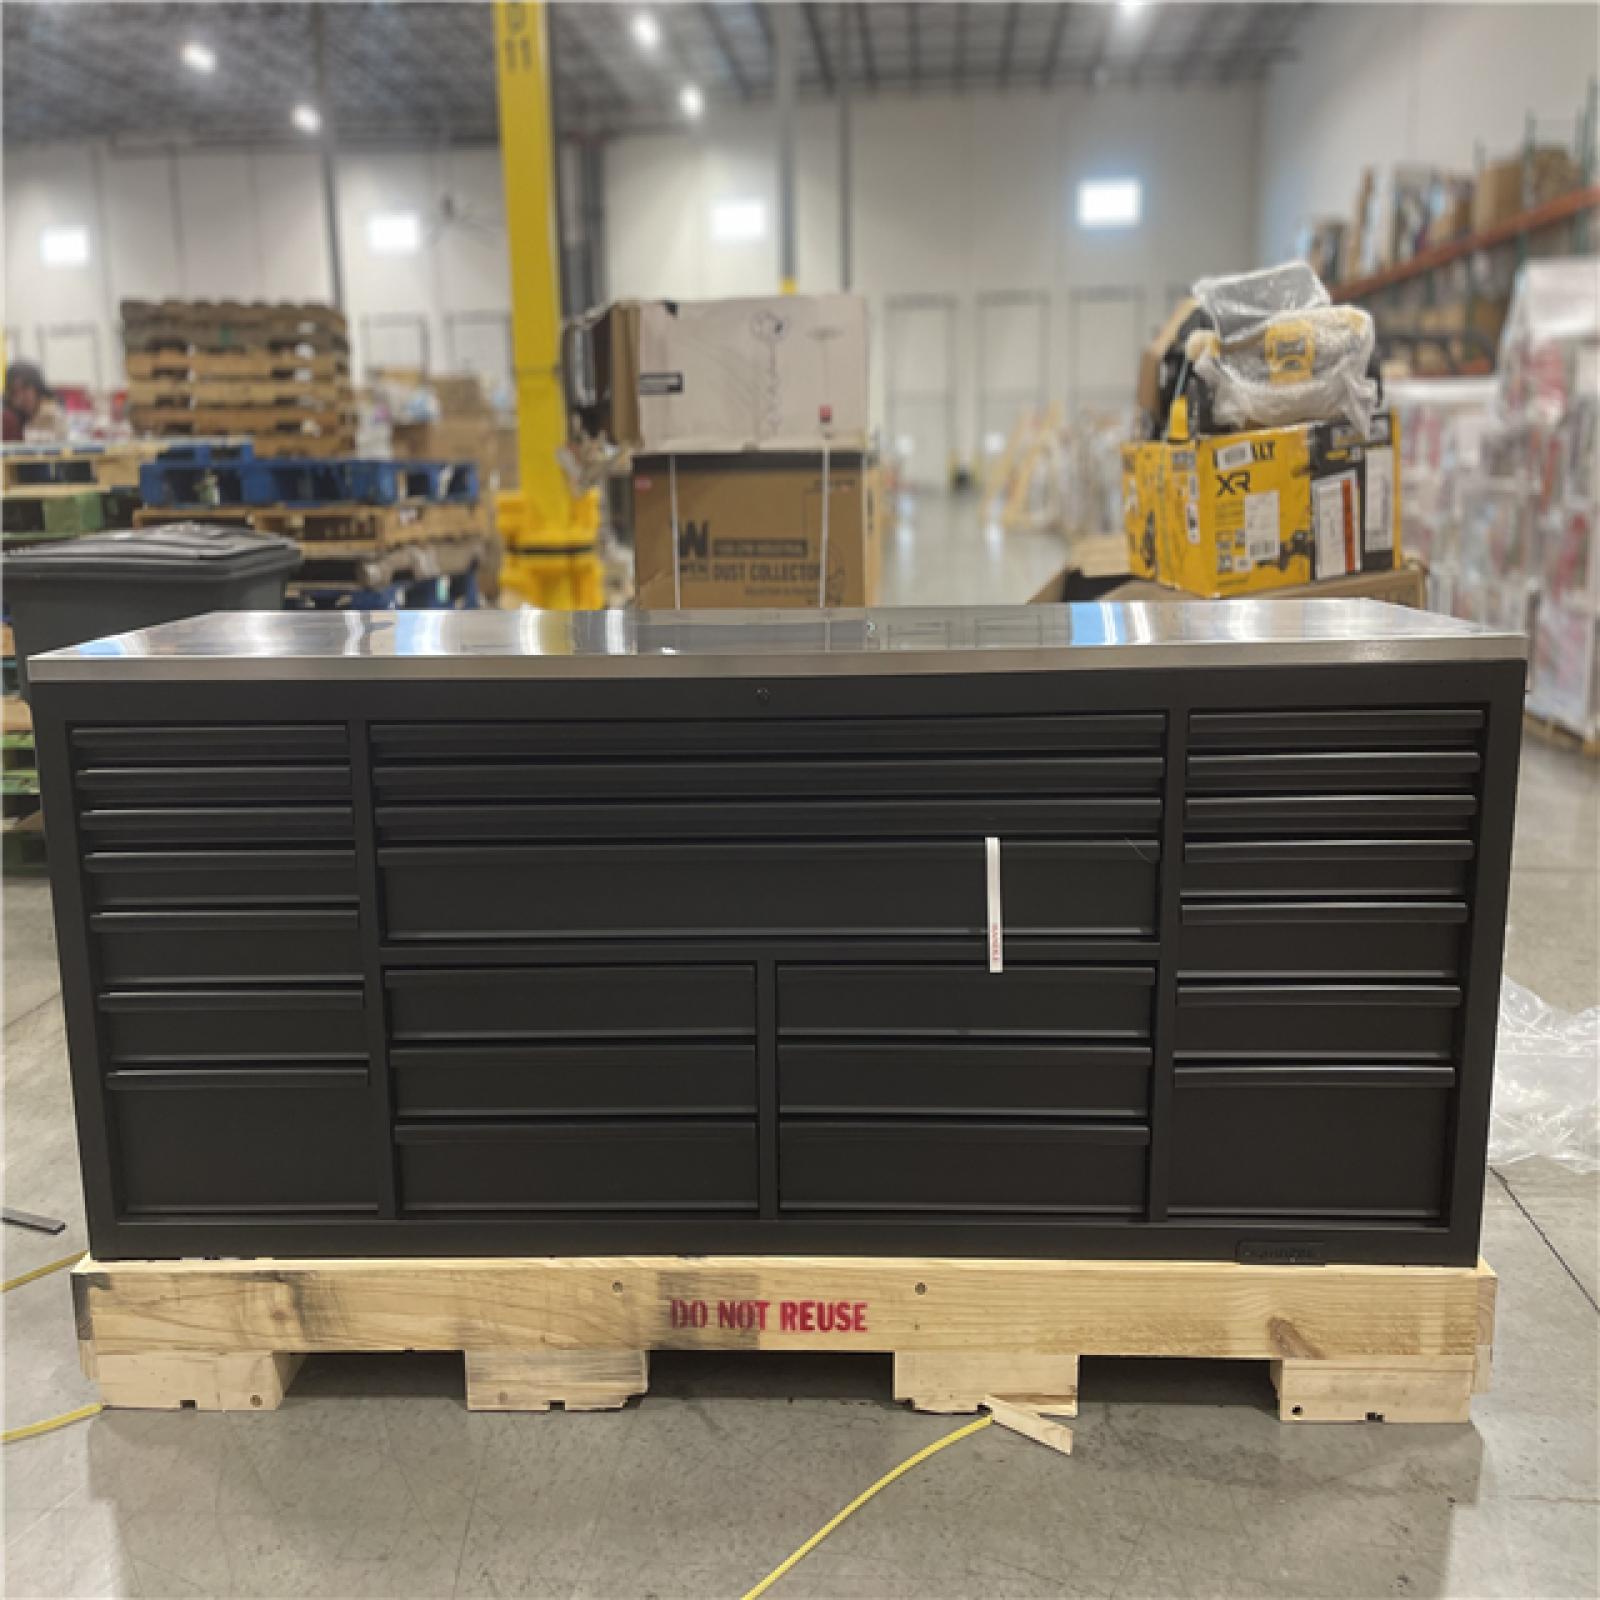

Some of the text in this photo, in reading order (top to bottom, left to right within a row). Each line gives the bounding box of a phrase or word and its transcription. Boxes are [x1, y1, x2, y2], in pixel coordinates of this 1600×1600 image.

[1217, 471, 1251, 496] XR
[671, 1300, 868, 1332] DO NOT REUSE
